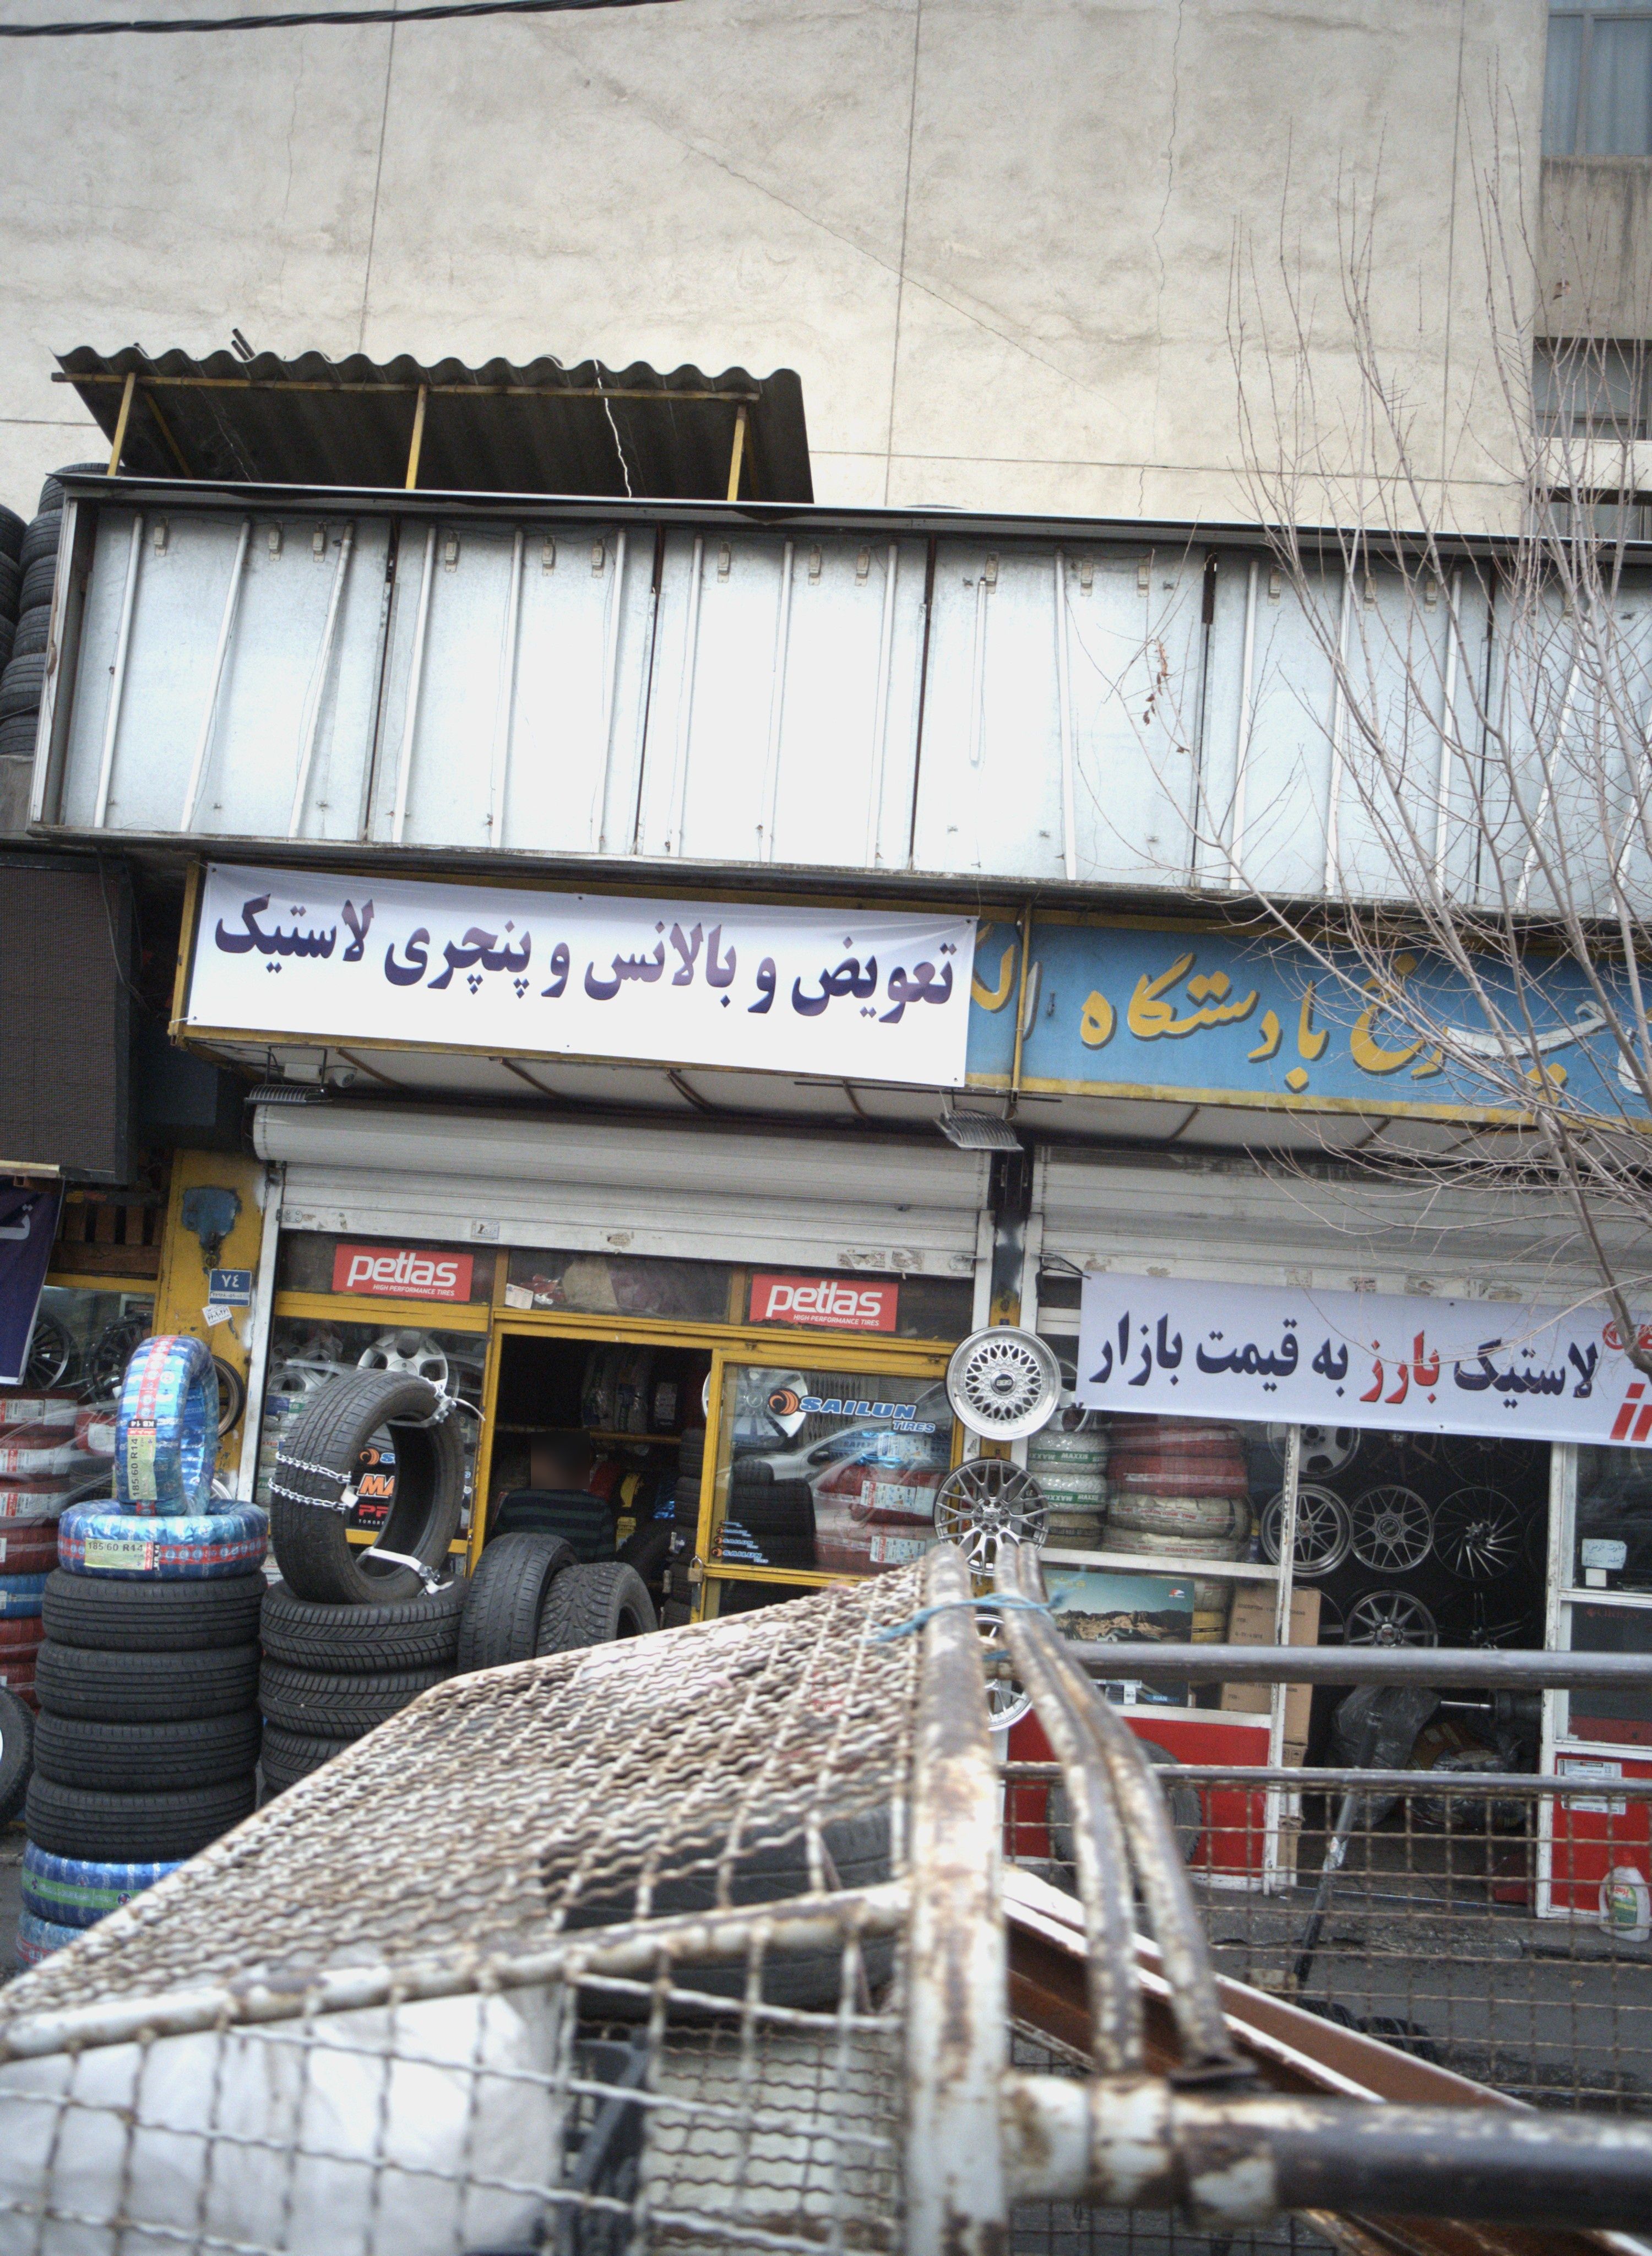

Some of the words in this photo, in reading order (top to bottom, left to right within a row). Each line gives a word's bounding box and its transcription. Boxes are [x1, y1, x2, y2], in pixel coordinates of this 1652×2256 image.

[215, 893, 374, 974] لاستیک
[384, 920, 531, 999] پنچری
[541, 942, 569, 998] و
[584, 921, 737, 1007] بالانس
[748, 957, 776, 1014] و
[792, 937, 957, 1023] تعویض
[1285, 980, 1328, 1093] با
[347, 1251, 458, 1287] petlas
[389, 1285, 436, 1295] PERFORMANCE
[765, 1281, 883, 1317] petlas
[811, 1315, 859, 1325] PERFORMANCE
[1089, 1310, 1183, 1387] بازار
[1195, 1318, 1299, 1392] قیمت
[1312, 1337, 1349, 1397] به
[1359, 1329, 1441, 1405] بارز
[1453, 1337, 1599, 1409] لاستیک
[800, 1396, 917, 1419] SAILUN
[892, 1420, 936, 1433] TIRES
[131, 1463, 140, 1496] 185/60
